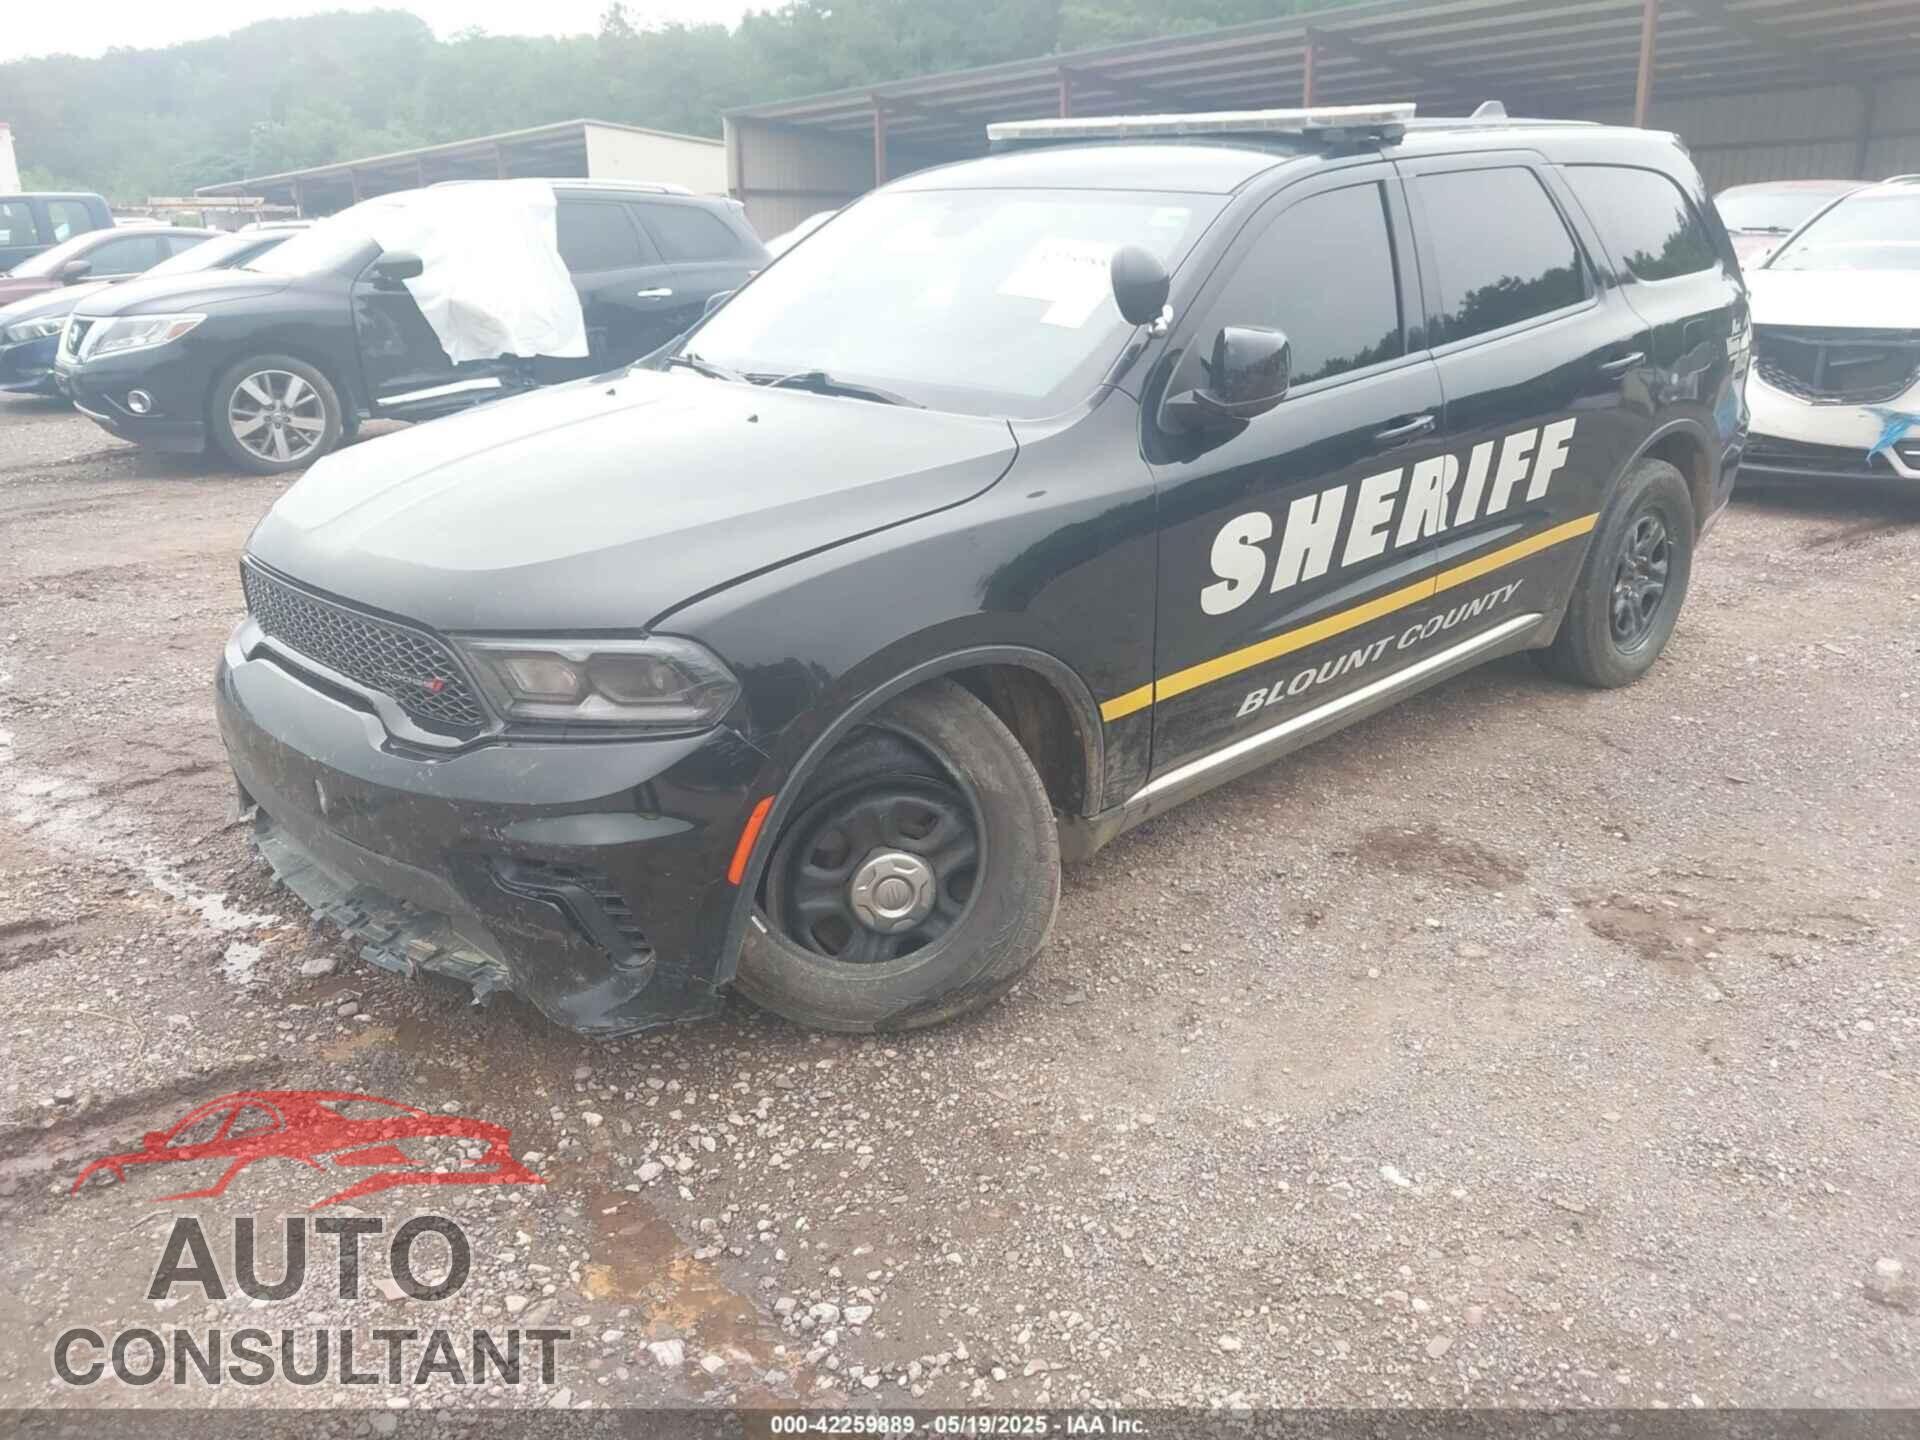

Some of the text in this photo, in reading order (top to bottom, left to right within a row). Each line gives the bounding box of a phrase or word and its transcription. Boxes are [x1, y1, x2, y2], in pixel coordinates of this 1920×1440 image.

[1200, 417, 1577, 615] SHERIFF
[1235, 579, 1524, 718] BLOUNT COUNTY
